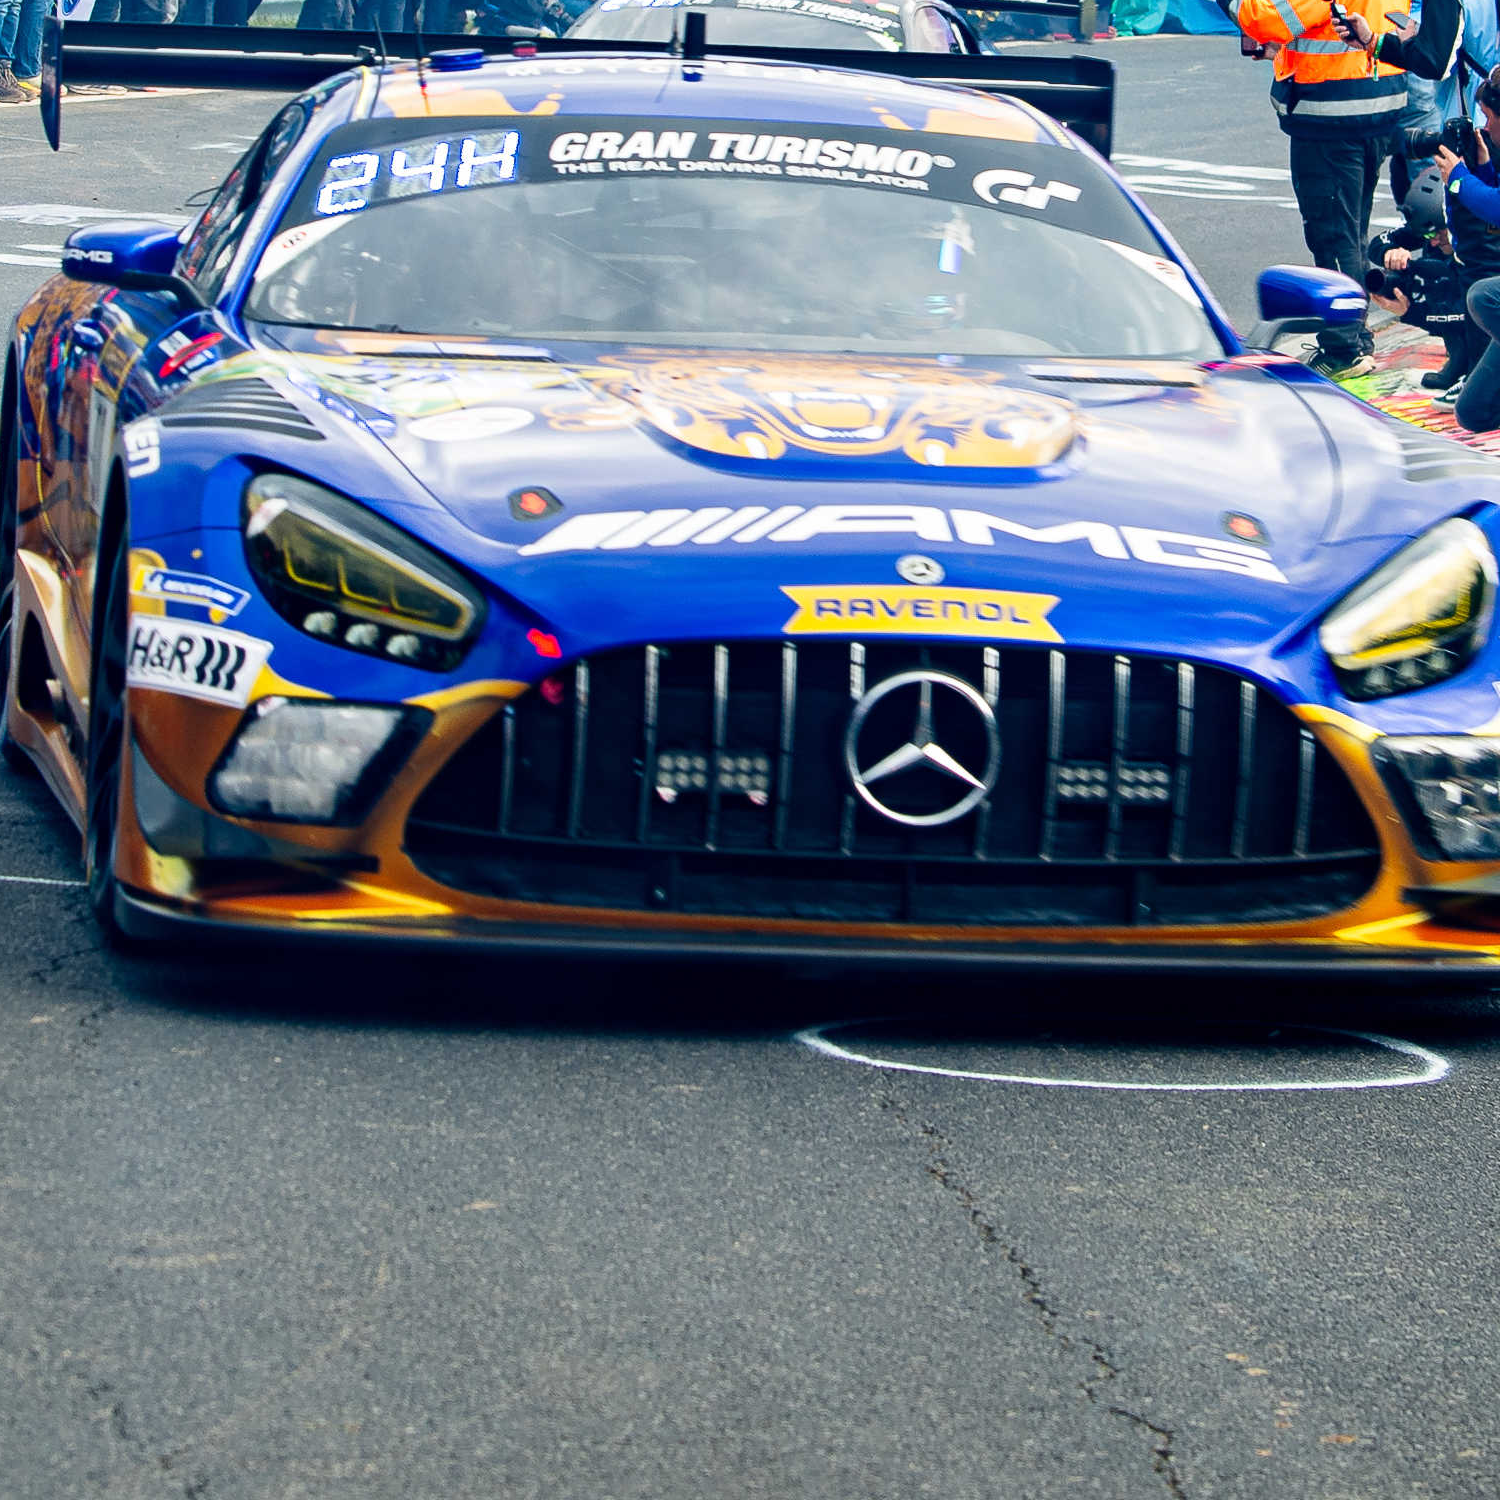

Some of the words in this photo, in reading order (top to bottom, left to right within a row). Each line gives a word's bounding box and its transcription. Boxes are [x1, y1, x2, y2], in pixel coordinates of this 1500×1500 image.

[548, 131, 698, 163] GRAN
[316, 129, 521, 216] 24H
[552, 163, 605, 174] THE
[608, 161, 675, 173] REAL
[678, 161, 783, 176] DRIVING
[784, 165, 930, 191] SIMULATOR
[67, 248, 113, 264] AMG
[768, 505, 1290, 584] AMG
[814, 598, 1033, 625] RAVENOL
[129, 626, 195, 675] H&R
